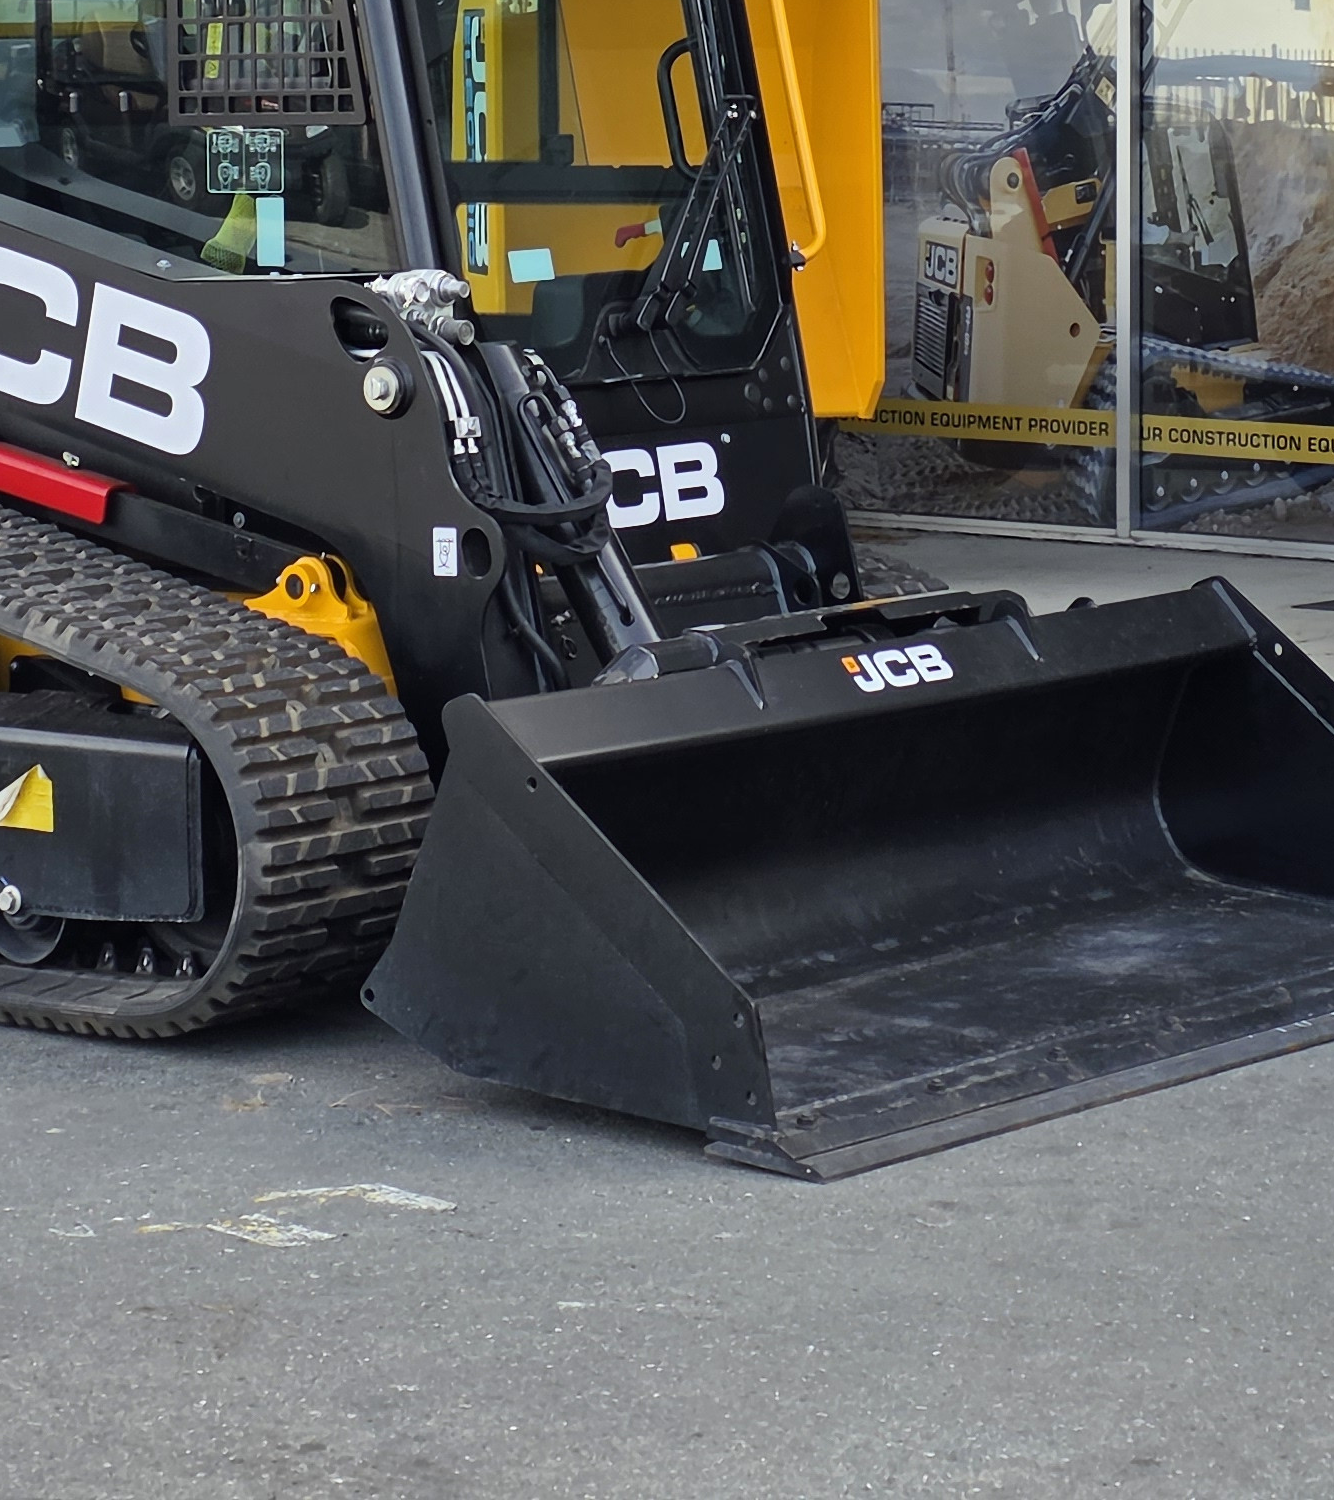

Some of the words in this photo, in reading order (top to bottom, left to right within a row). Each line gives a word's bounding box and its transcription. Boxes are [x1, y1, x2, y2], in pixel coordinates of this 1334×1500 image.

[925, 244, 958, 286] JCB
[930, 411, 1023, 432] EQUIPMENT
[1028, 416, 1110, 437] PROVIDER
[1168, 427, 1302, 452] CONSTRUCTION
[601, 441, 726, 529] CB
[853, 643, 954, 693] JCB
